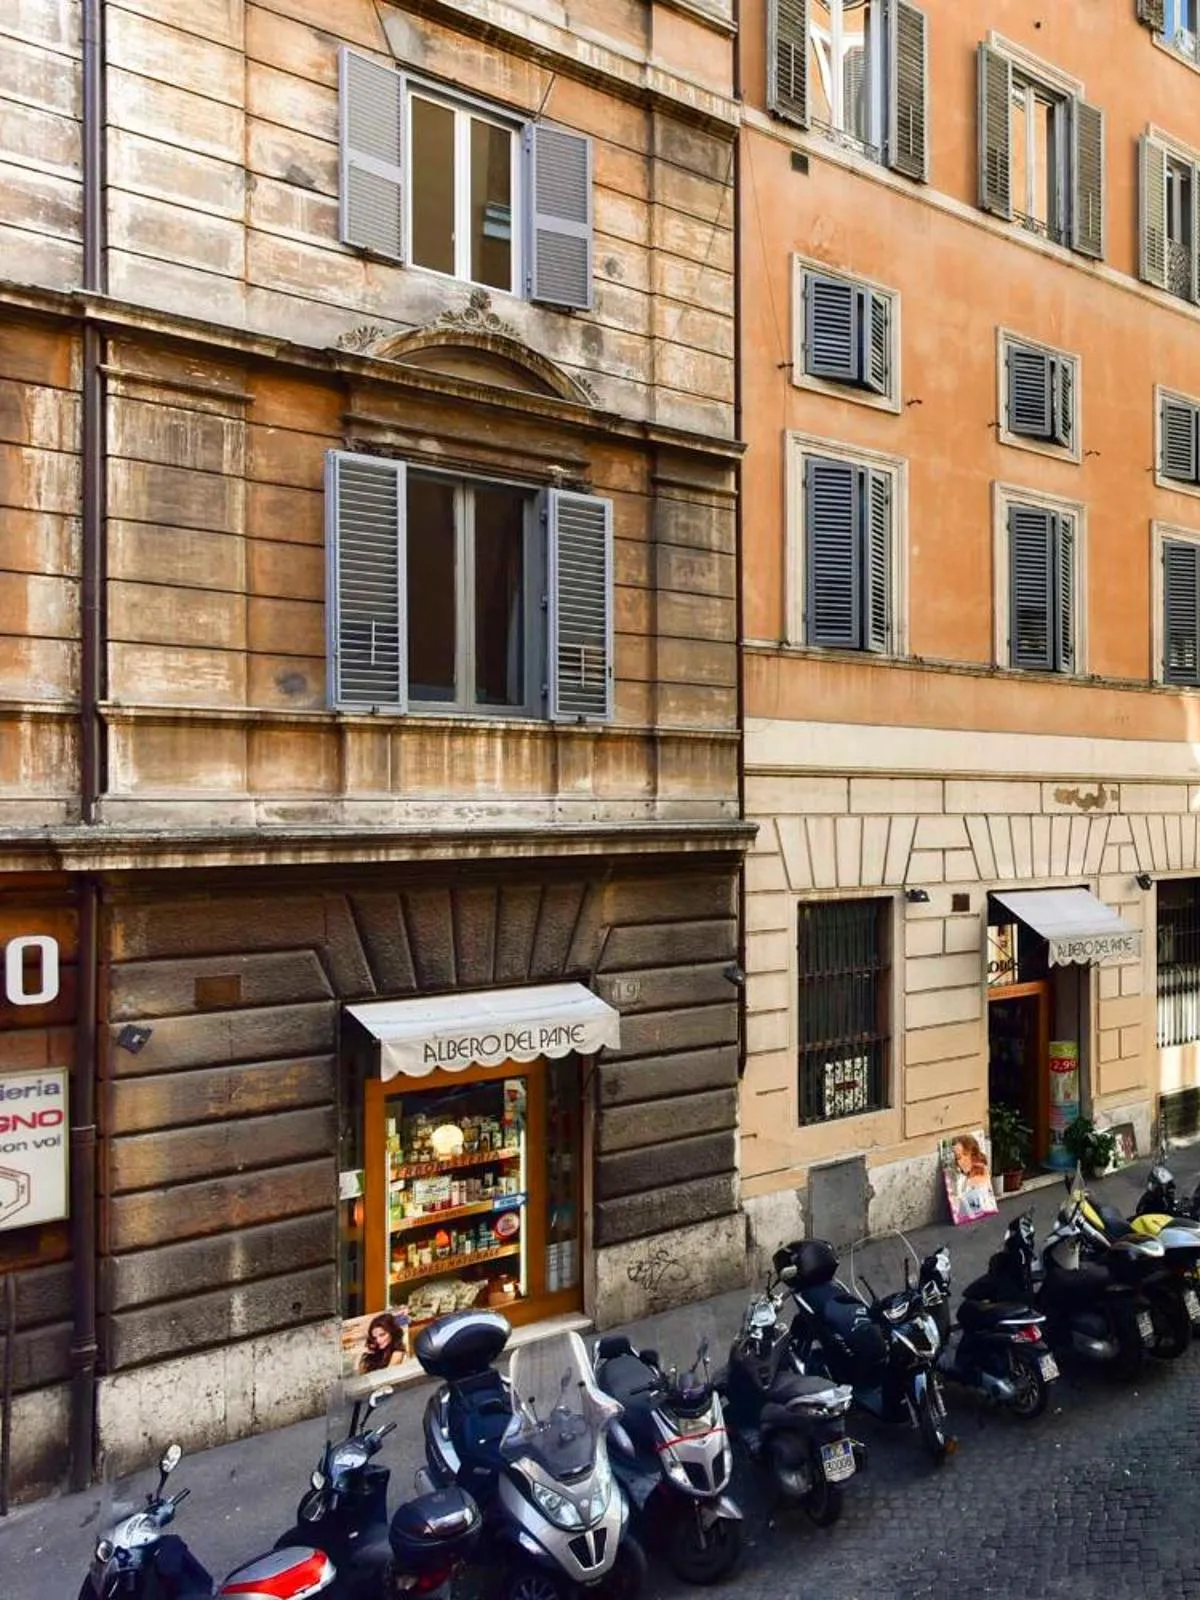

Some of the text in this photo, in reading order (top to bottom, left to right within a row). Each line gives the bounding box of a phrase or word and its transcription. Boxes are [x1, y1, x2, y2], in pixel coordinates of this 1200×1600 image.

[424, 1024, 585, 1063] ALBERO DEL PANE
